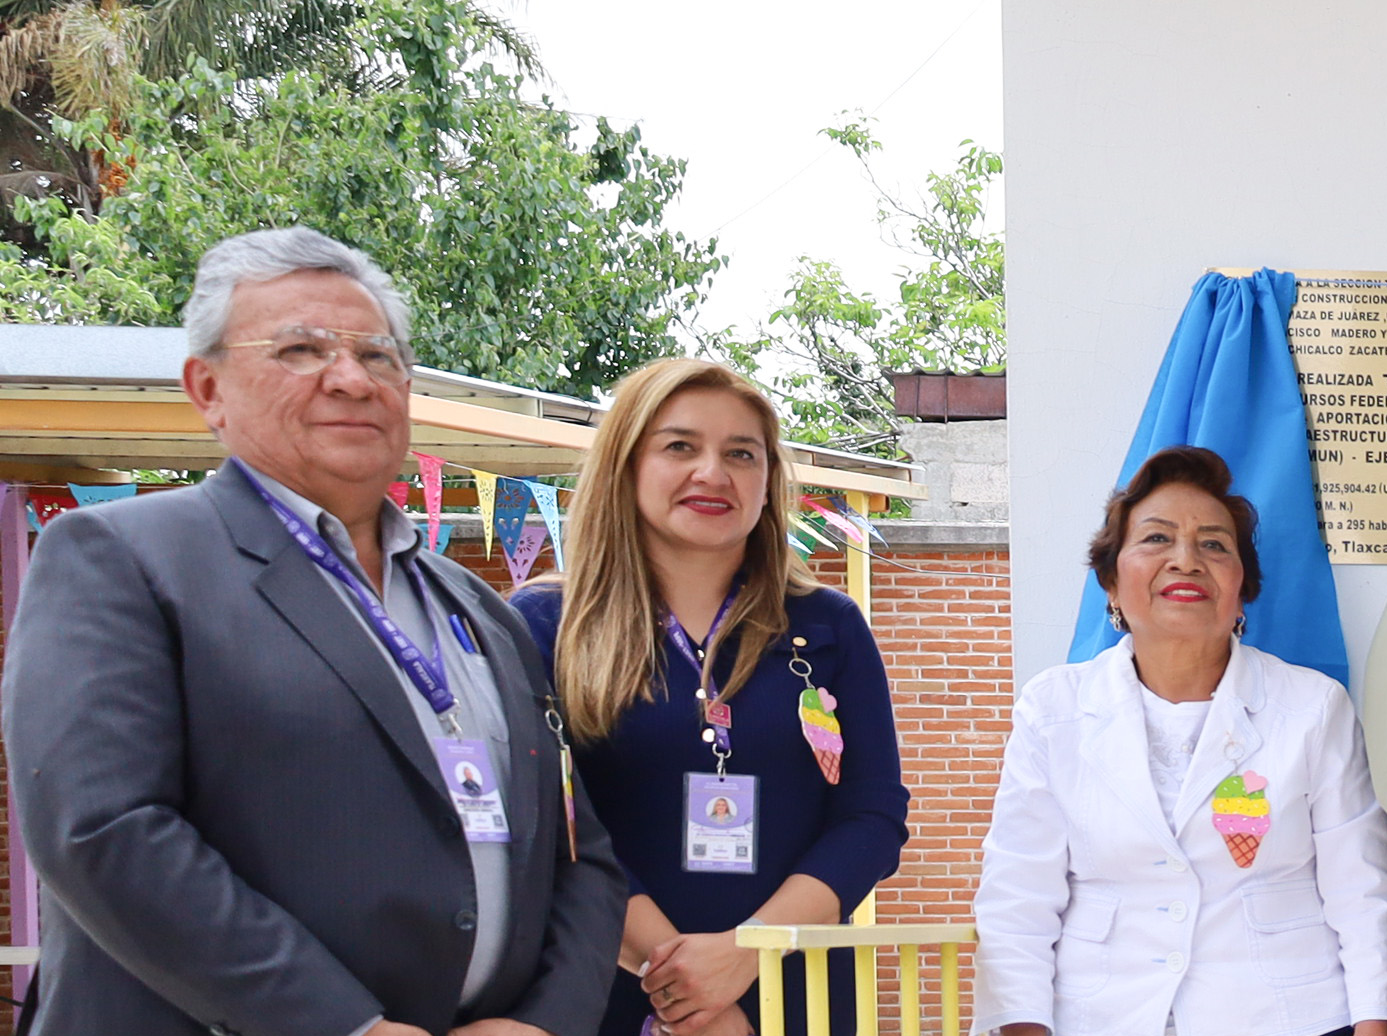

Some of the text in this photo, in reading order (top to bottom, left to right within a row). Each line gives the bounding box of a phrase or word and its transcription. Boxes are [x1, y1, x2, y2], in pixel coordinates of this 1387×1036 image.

[1316, 278, 1330, 289] LA
[1333, 278, 1382, 290] SECCION
[1320, 311, 1334, 320] DE
[1331, 328, 1377, 338] MADERO
[1380, 330, 1387, 339] Y
[1297, 372, 1374, 386] REALIZADA
[1324, 501, 1336, 511] M.
[1336, 522, 1343, 530] a
[1346, 520, 1366, 530] 295
